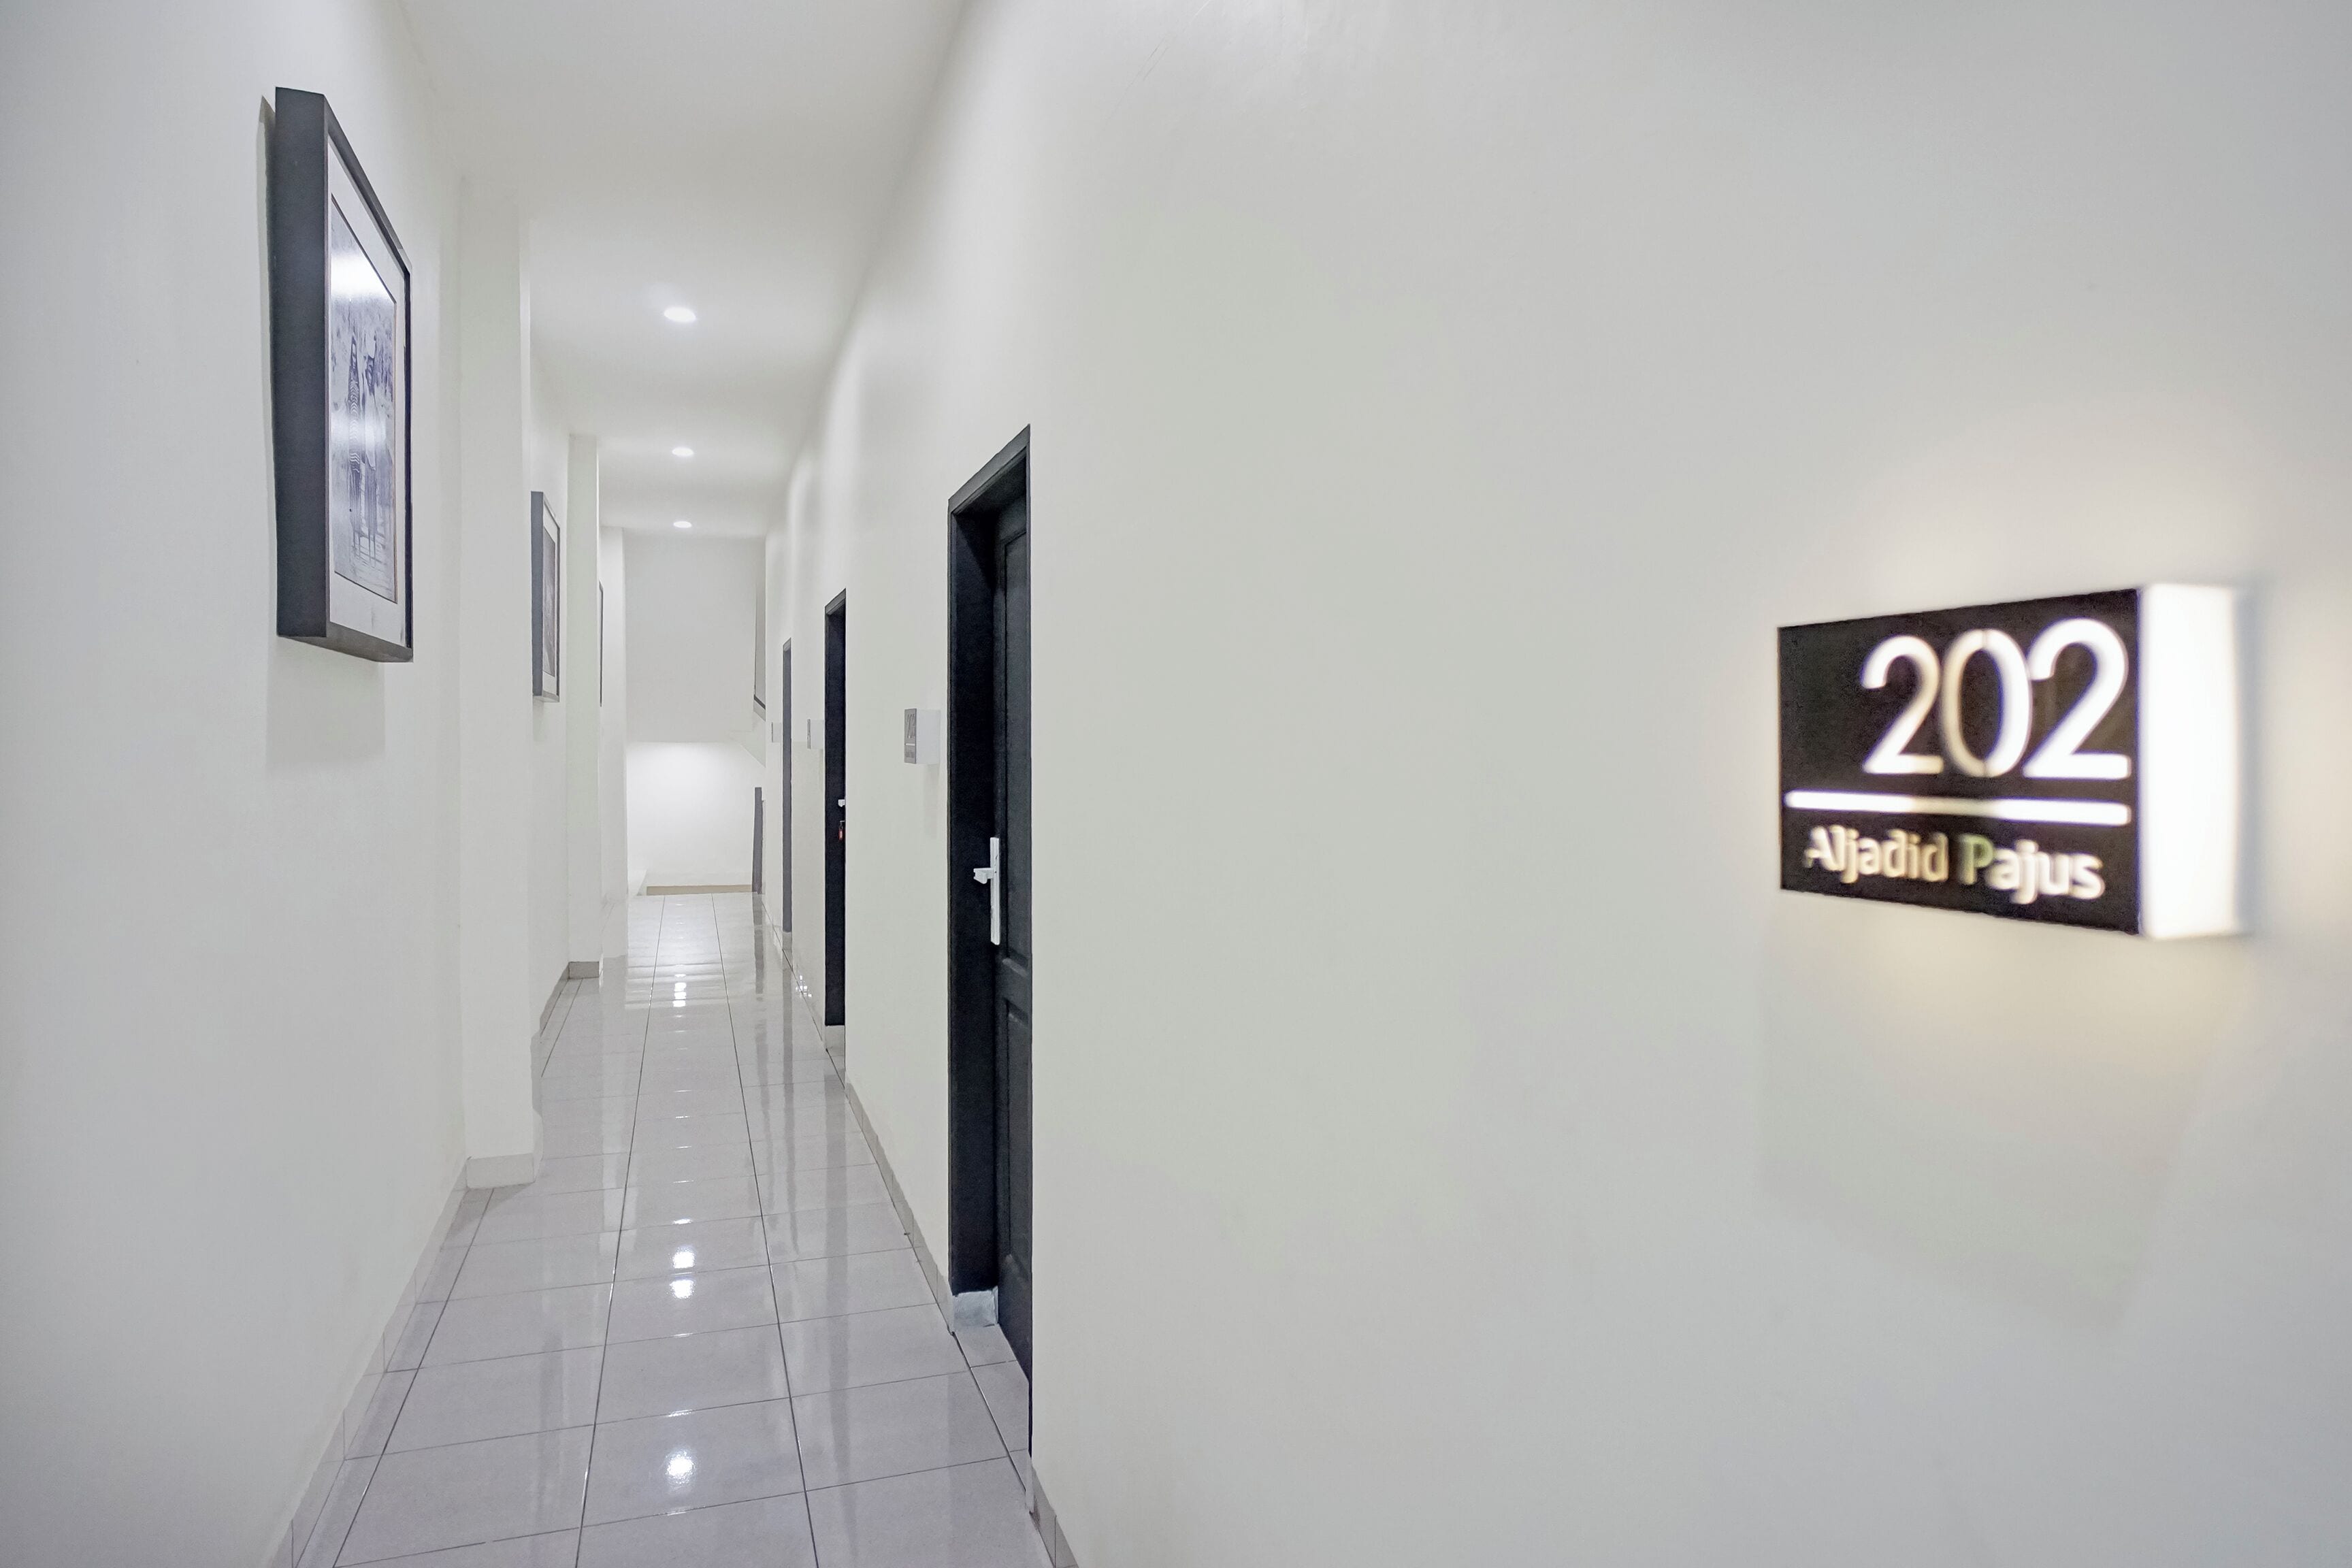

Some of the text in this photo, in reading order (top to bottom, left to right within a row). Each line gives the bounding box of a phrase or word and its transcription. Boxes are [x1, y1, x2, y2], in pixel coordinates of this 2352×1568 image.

[1861, 618, 2131, 779] 202
[1805, 826, 2105, 904] Aljadid Pajus
